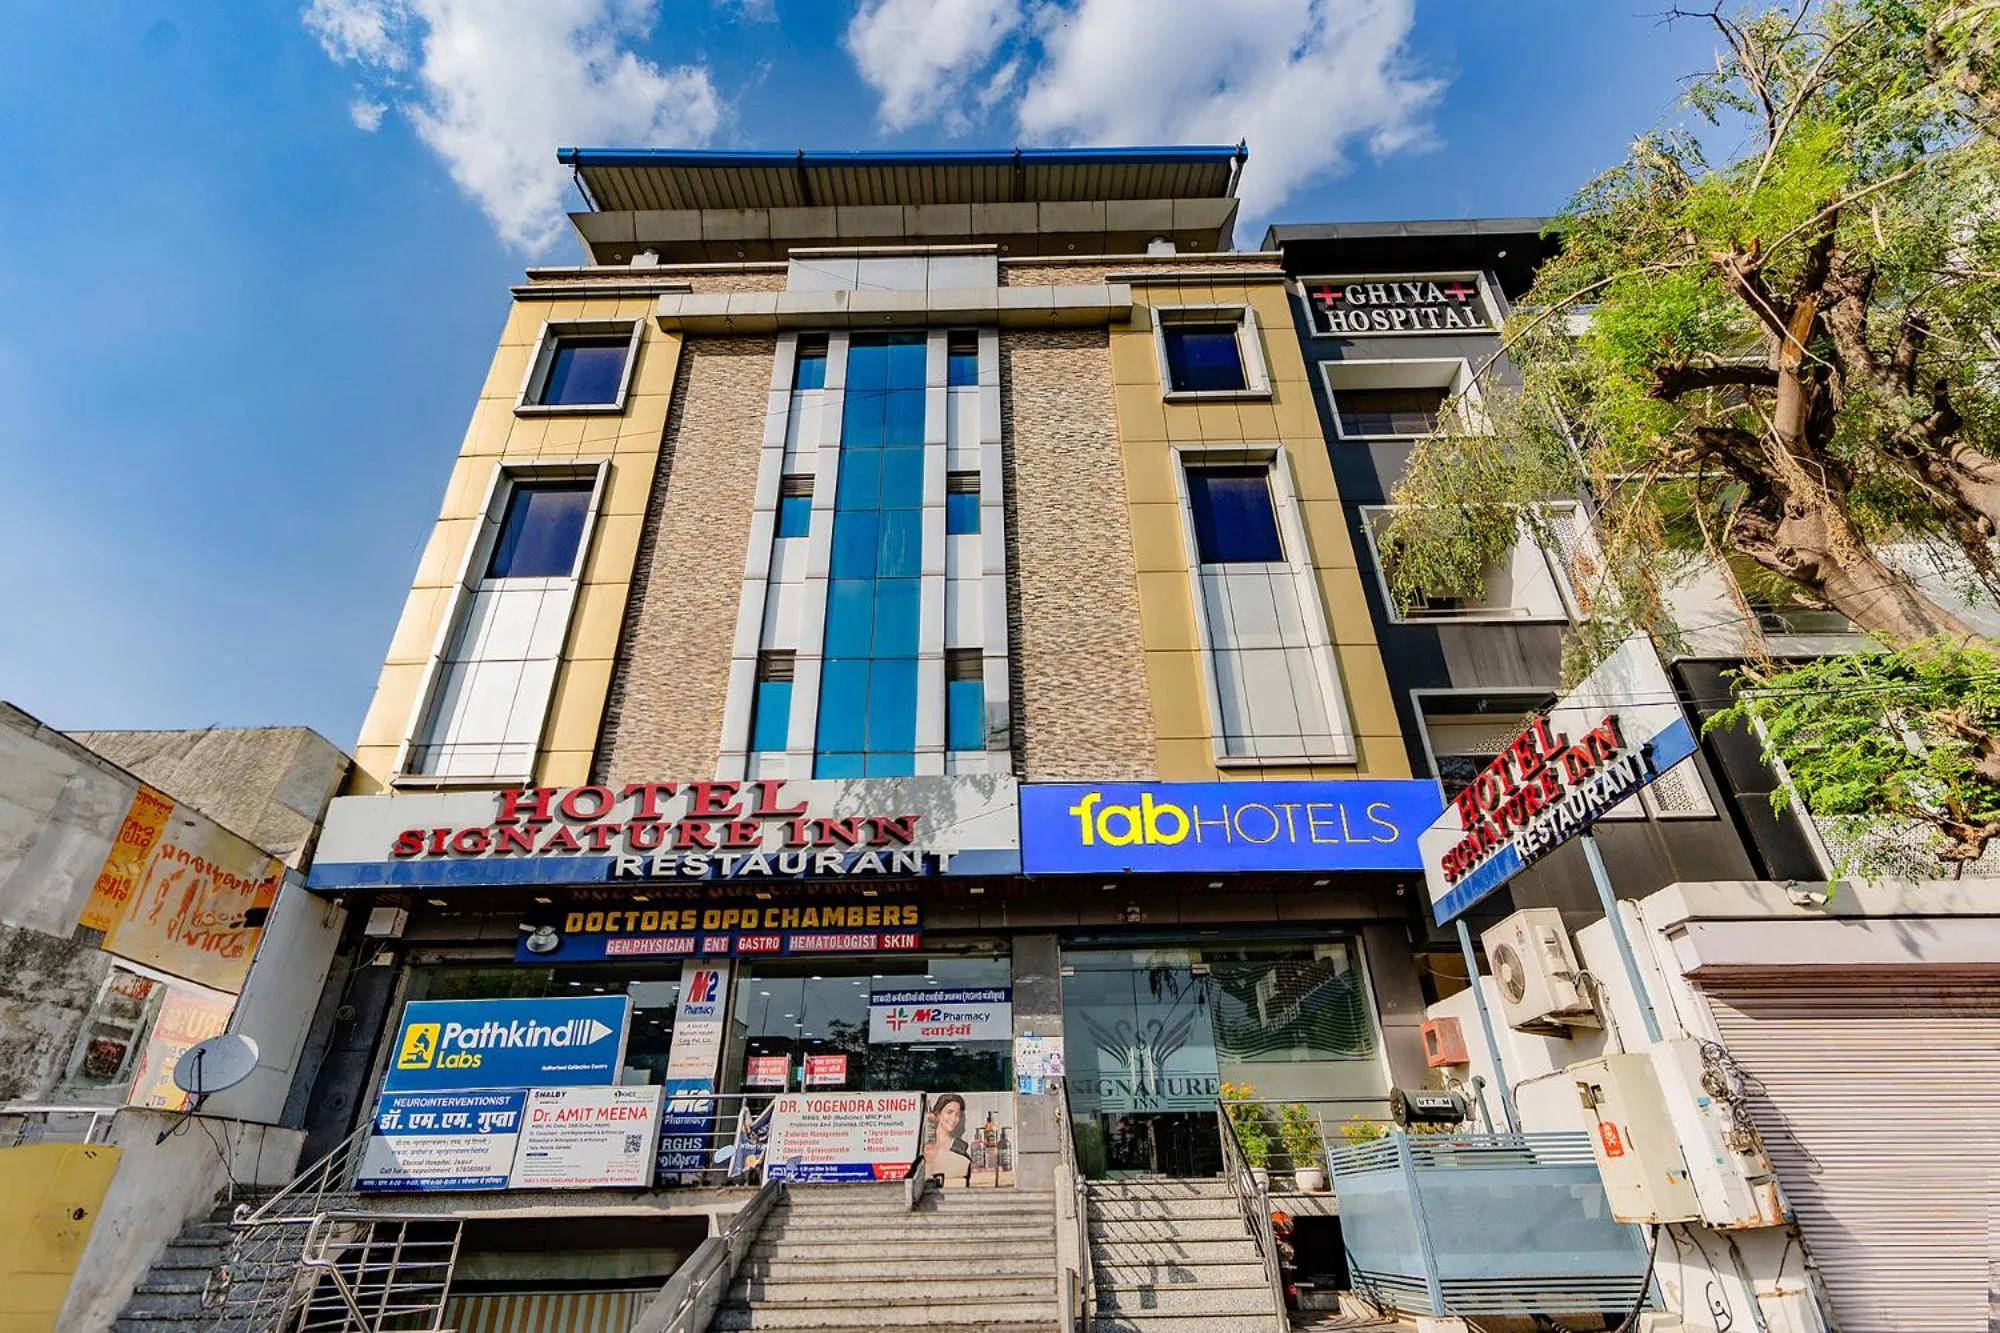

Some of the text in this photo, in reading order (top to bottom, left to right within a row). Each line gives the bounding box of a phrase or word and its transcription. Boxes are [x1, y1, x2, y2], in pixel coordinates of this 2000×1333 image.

[1345, 282, 1448, 305] GHIYA
[1325, 306, 1487, 332] HOSPITAL
[1456, 715, 1570, 832] HOTEL
[495, 780, 808, 823] HOTEL
[1440, 714, 1627, 884] SIGNATURE INN
[1514, 749, 1652, 859] RESTAURANT
[394, 815, 921, 856] SIGNATURE INN
[614, 850, 959, 877] RESTAURANT
[565, 905, 919, 933] DOCTORS OPD CHAMBERS
[703, 937, 728, 952] ENT
[738, 936, 780, 950] GASTRO
[789, 934, 877, 950] HEMATOLOGIST
[884, 934, 915, 949] SKIN
[683, 1004, 715, 1017] Pharmacy
[943, 1012, 991, 1022] Pharmacy
[441, 1019, 574, 1049] Pathkind
[436, 1051, 482, 1068] Labs
[1071, 1077, 1219, 1096] SIGNATURE
[393, 1096, 511, 1107] NEUROINTERVENTIONIST
[779, 1098, 916, 1113] DR. YOGENDRA SINGH
[1133, 1098, 1160, 1109] INN
[1418, 1098, 1451, 1106] UTTM
[380, 1109, 404, 1130] डॉ.
[477, 1111, 517, 1133] गुप्ता
[533, 1106, 648, 1122] Dr. AMIT MEENA
[662, 1137, 702, 1150] RGHS
